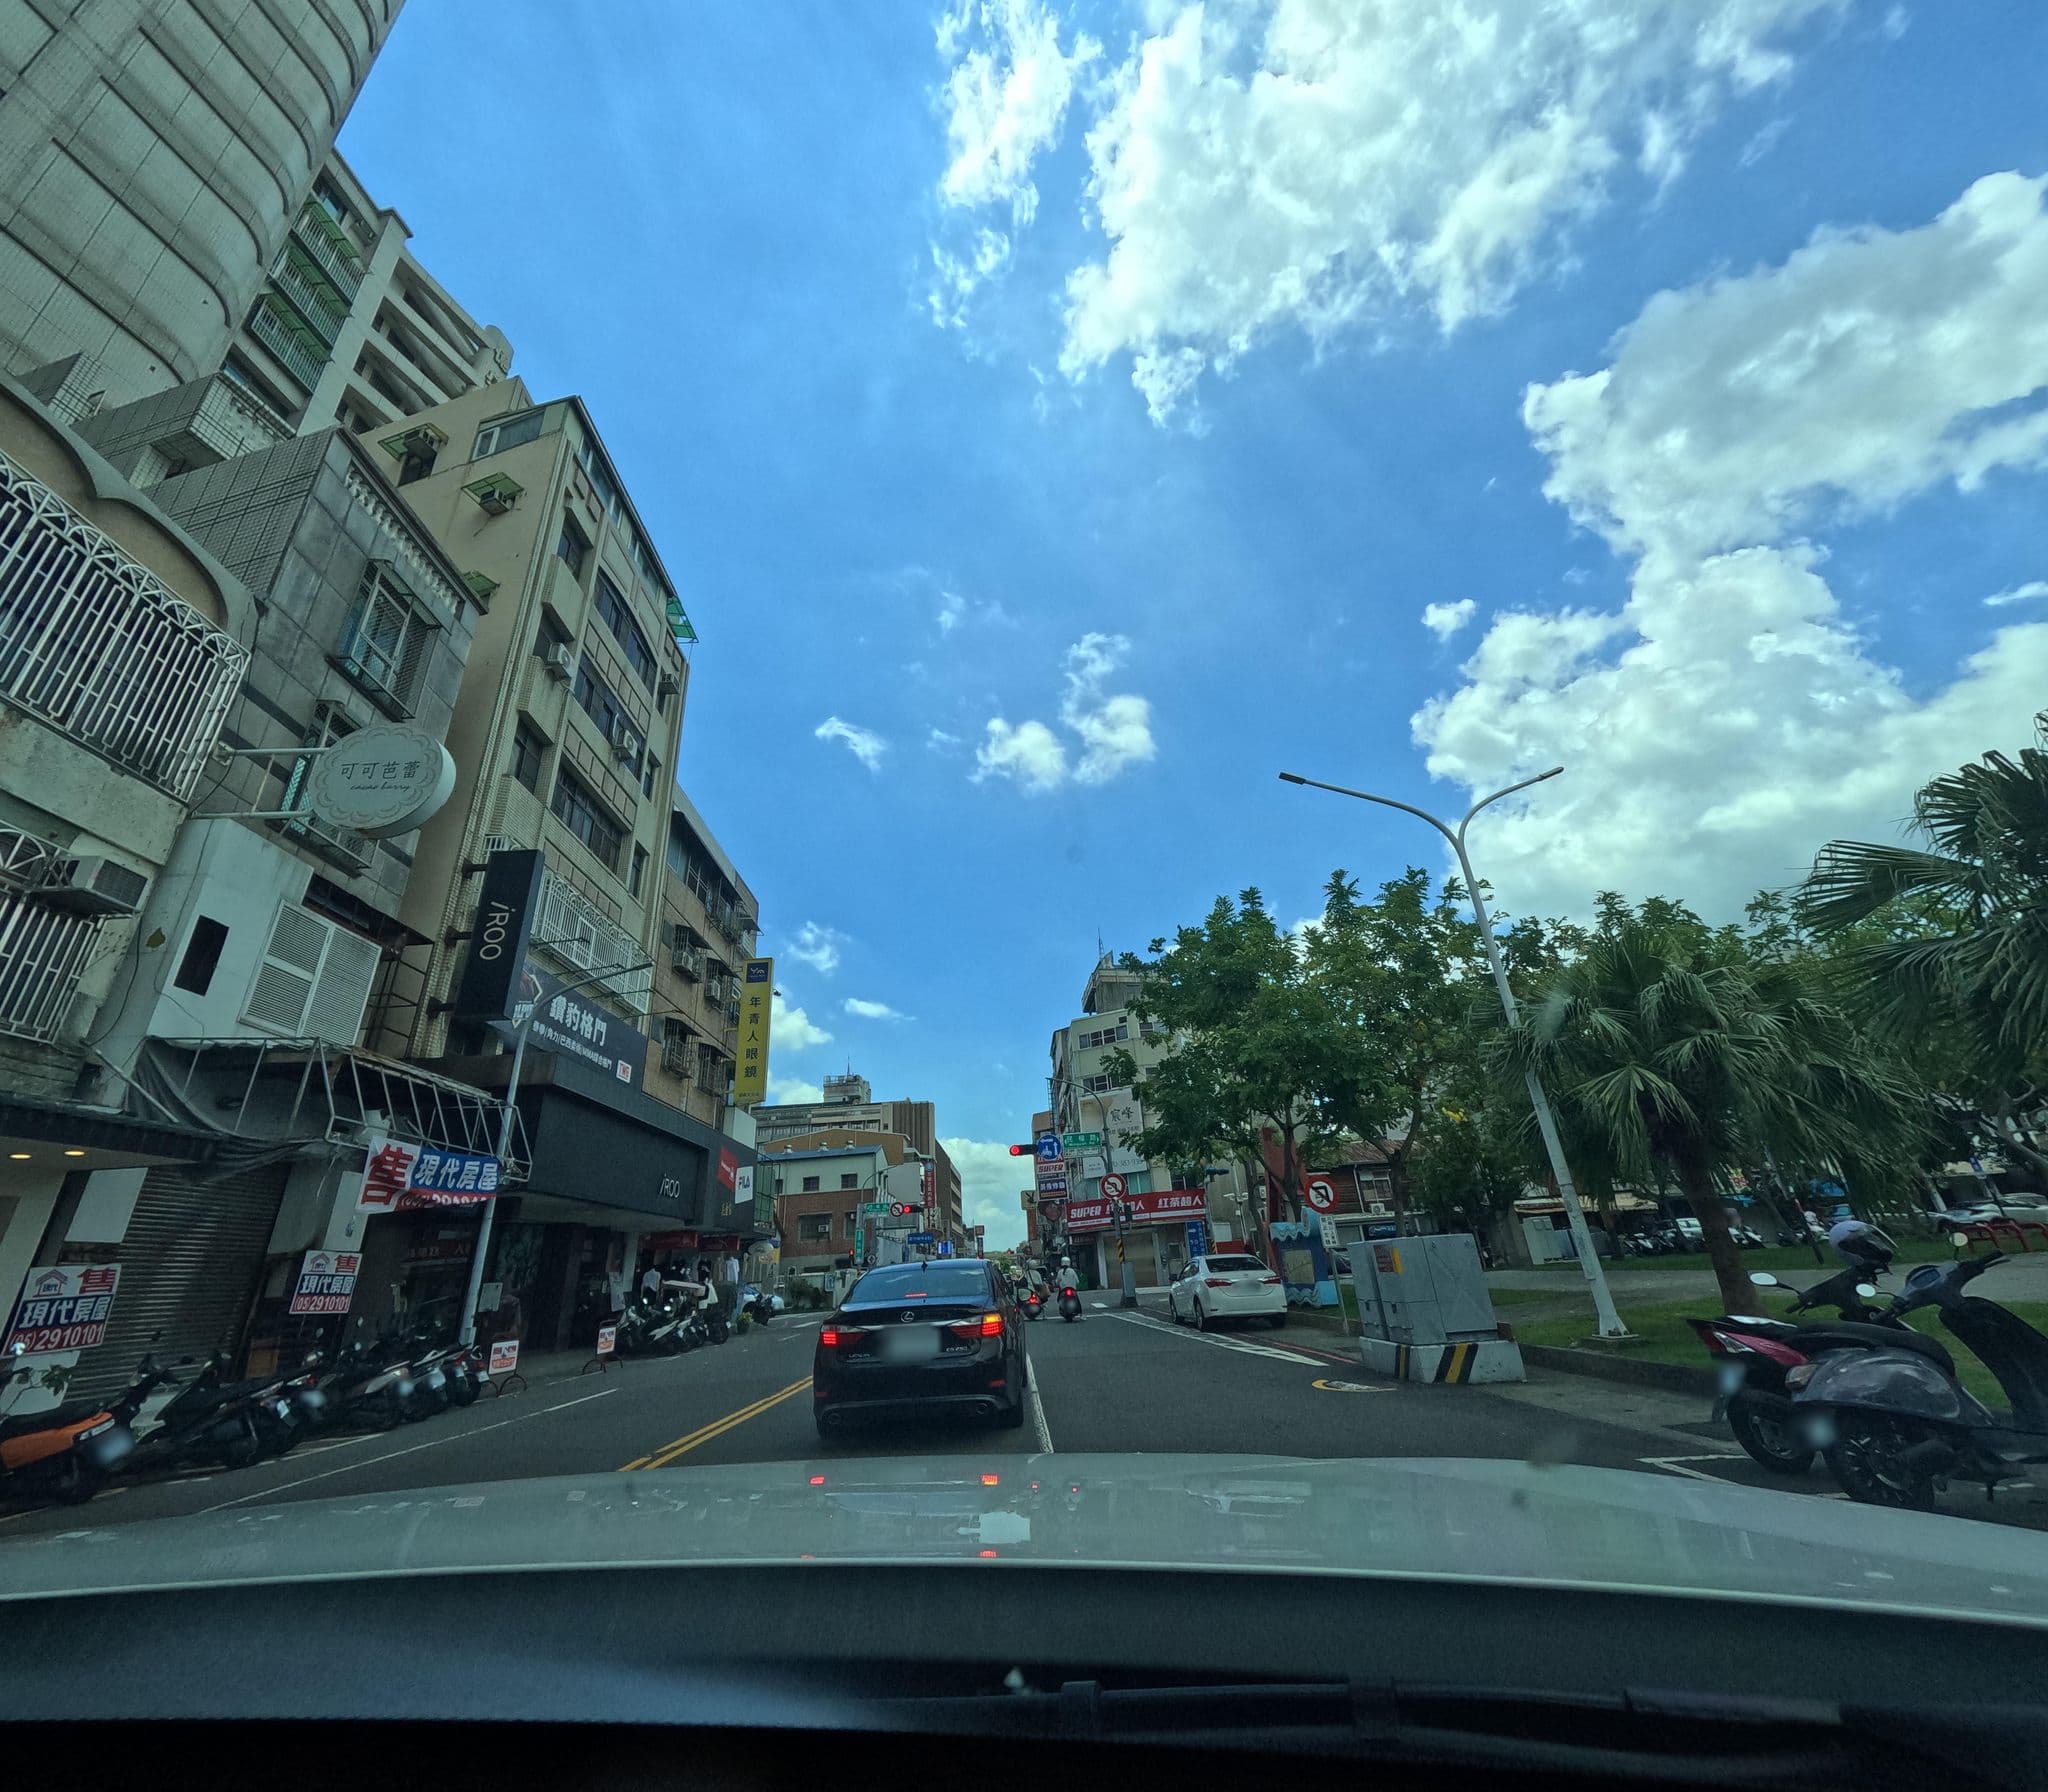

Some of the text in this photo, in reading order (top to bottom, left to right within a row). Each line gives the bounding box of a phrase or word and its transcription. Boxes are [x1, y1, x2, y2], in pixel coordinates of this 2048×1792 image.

[341, 761, 420, 780] 可可芭蕾
[479, 901, 516, 960] iROO
[744, 996, 761, 1078] 年青人眼鏡
[361, 1143, 414, 1205] 售
[415, 1154, 498, 1190] 現代房屋
[1070, 1205, 1102, 1219] SUPER
[79, 1267, 117, 1295] 售
[299, 1275, 354, 1294] 現代房屋
[19, 1296, 111, 1329] 現代房屋
